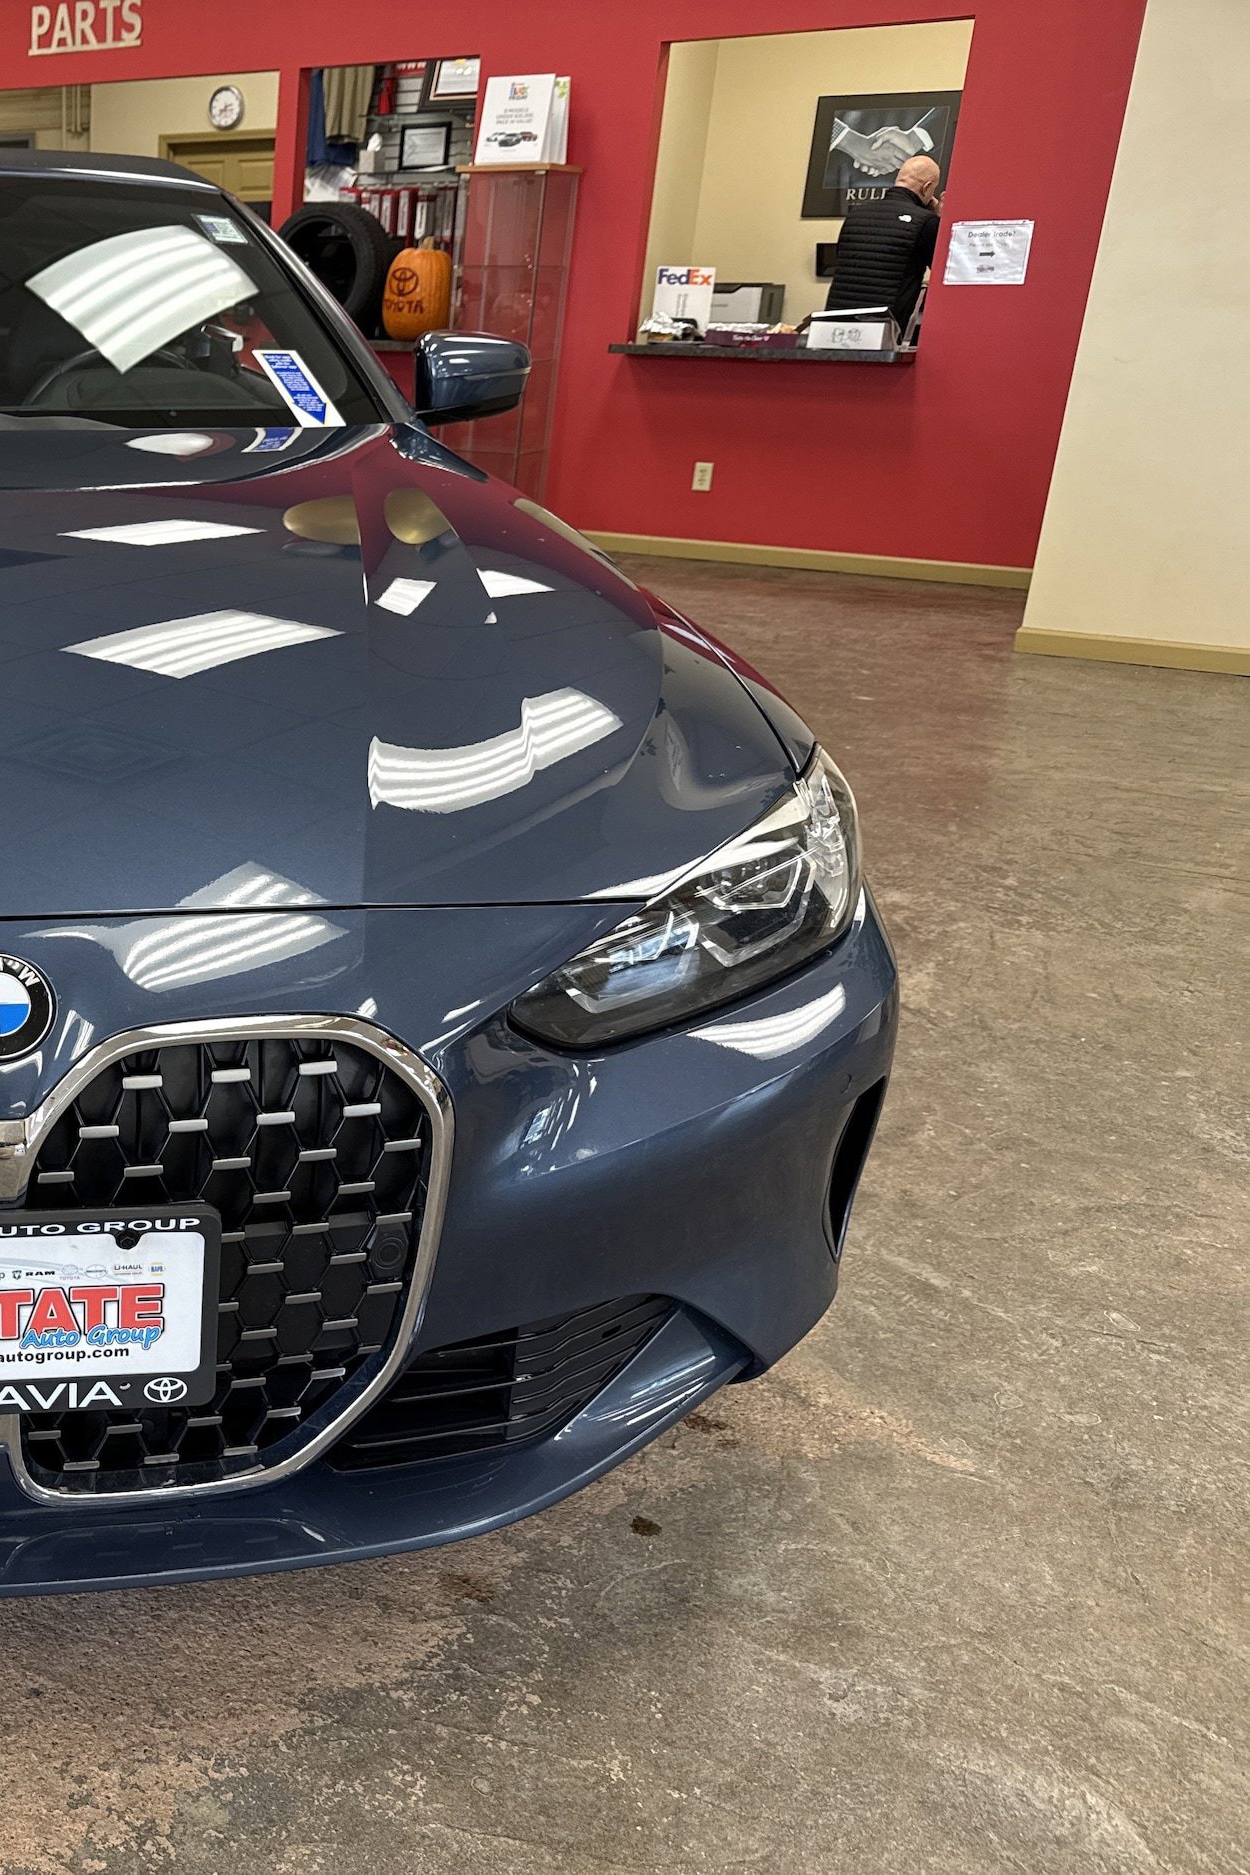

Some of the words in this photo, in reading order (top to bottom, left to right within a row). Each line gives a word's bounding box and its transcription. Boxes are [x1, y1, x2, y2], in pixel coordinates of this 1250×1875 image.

[31, 0, 142, 51] PARTS
[658, 268, 712, 286] FedEx
[76, 1217, 201, 1233] GROUP
[20, 1327, 81, 1350] Auto
[86, 1323, 163, 1351] Group
